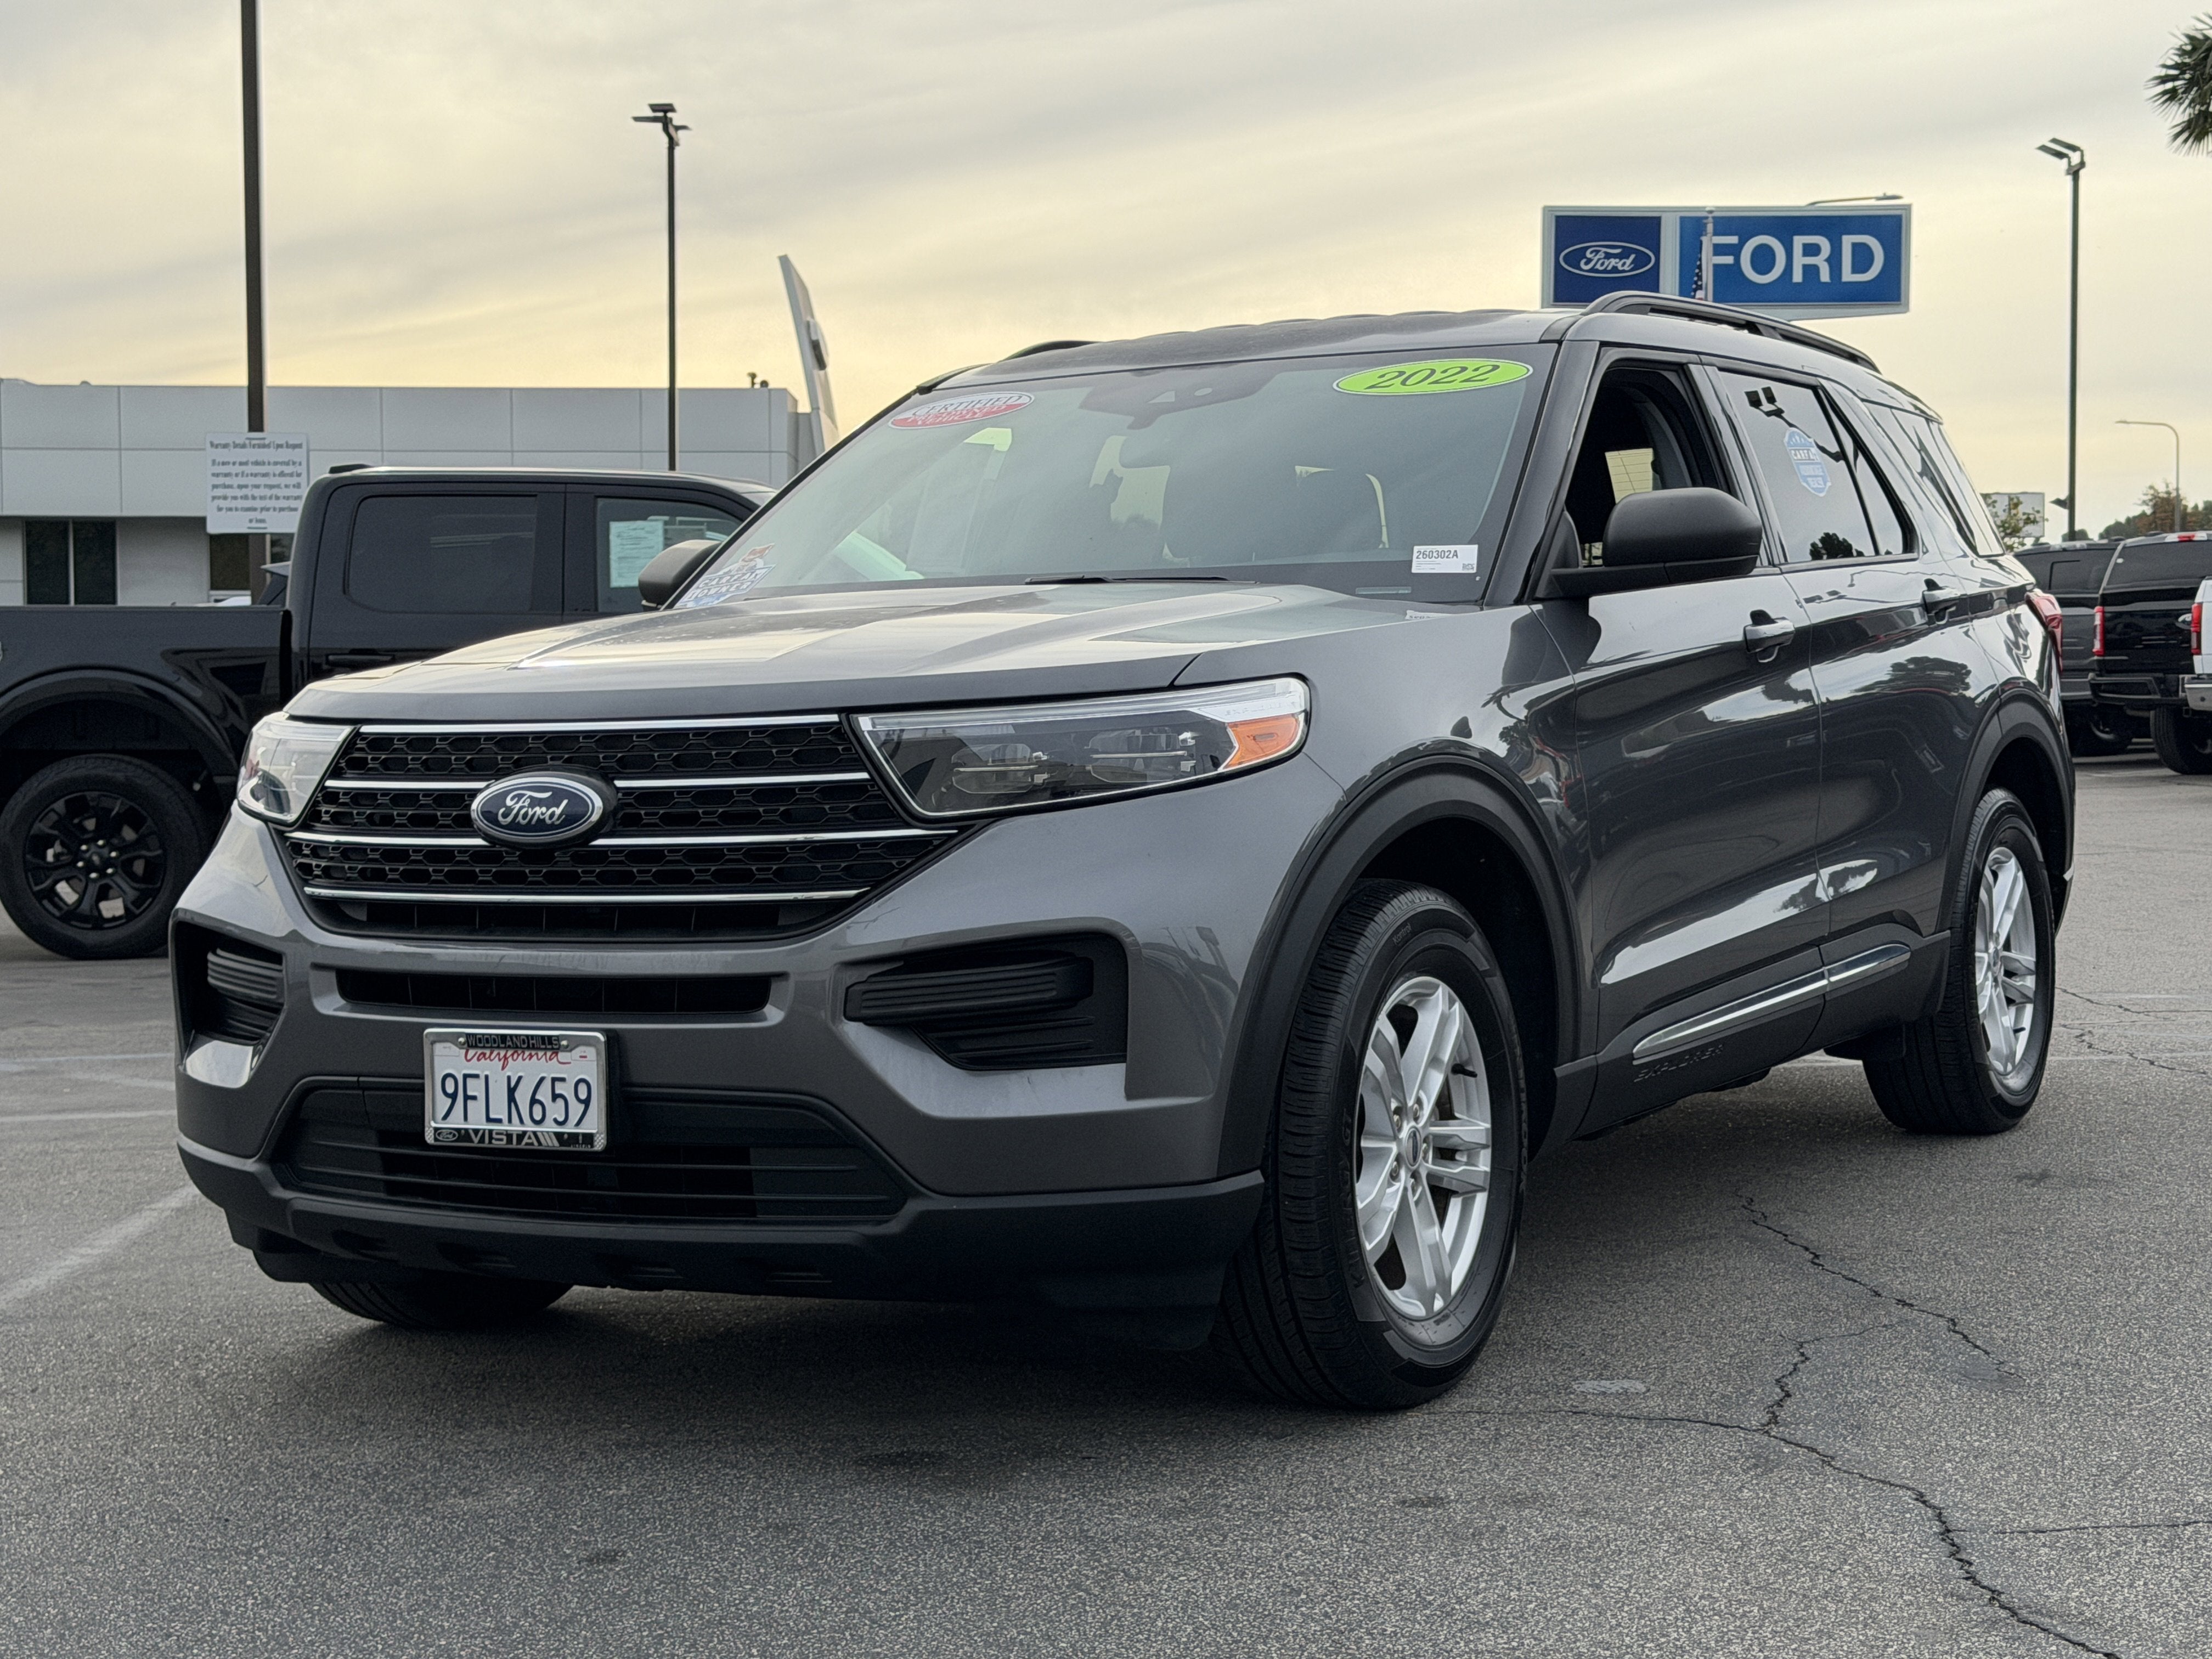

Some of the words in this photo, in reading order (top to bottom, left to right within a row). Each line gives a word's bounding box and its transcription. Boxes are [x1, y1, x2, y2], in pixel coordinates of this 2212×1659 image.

[1579, 246, 1635, 271] Ford
[1707, 234, 1885, 285] FORD
[1364, 364, 1501, 390] 2022
[912, 396, 1023, 416] CERTIFIED
[1416, 550, 1458, 559] 260302A
[699, 572, 762, 587] CARFAX
[497, 790, 568, 825] Ford
[467, 1034, 527, 1048] WOODLAND
[529, 1036, 560, 1049] HILLS
[464, 1048, 572, 1071] California
[441, 1072, 592, 1127] 9FLK659
[471, 1129, 539, 1147] VISTA
